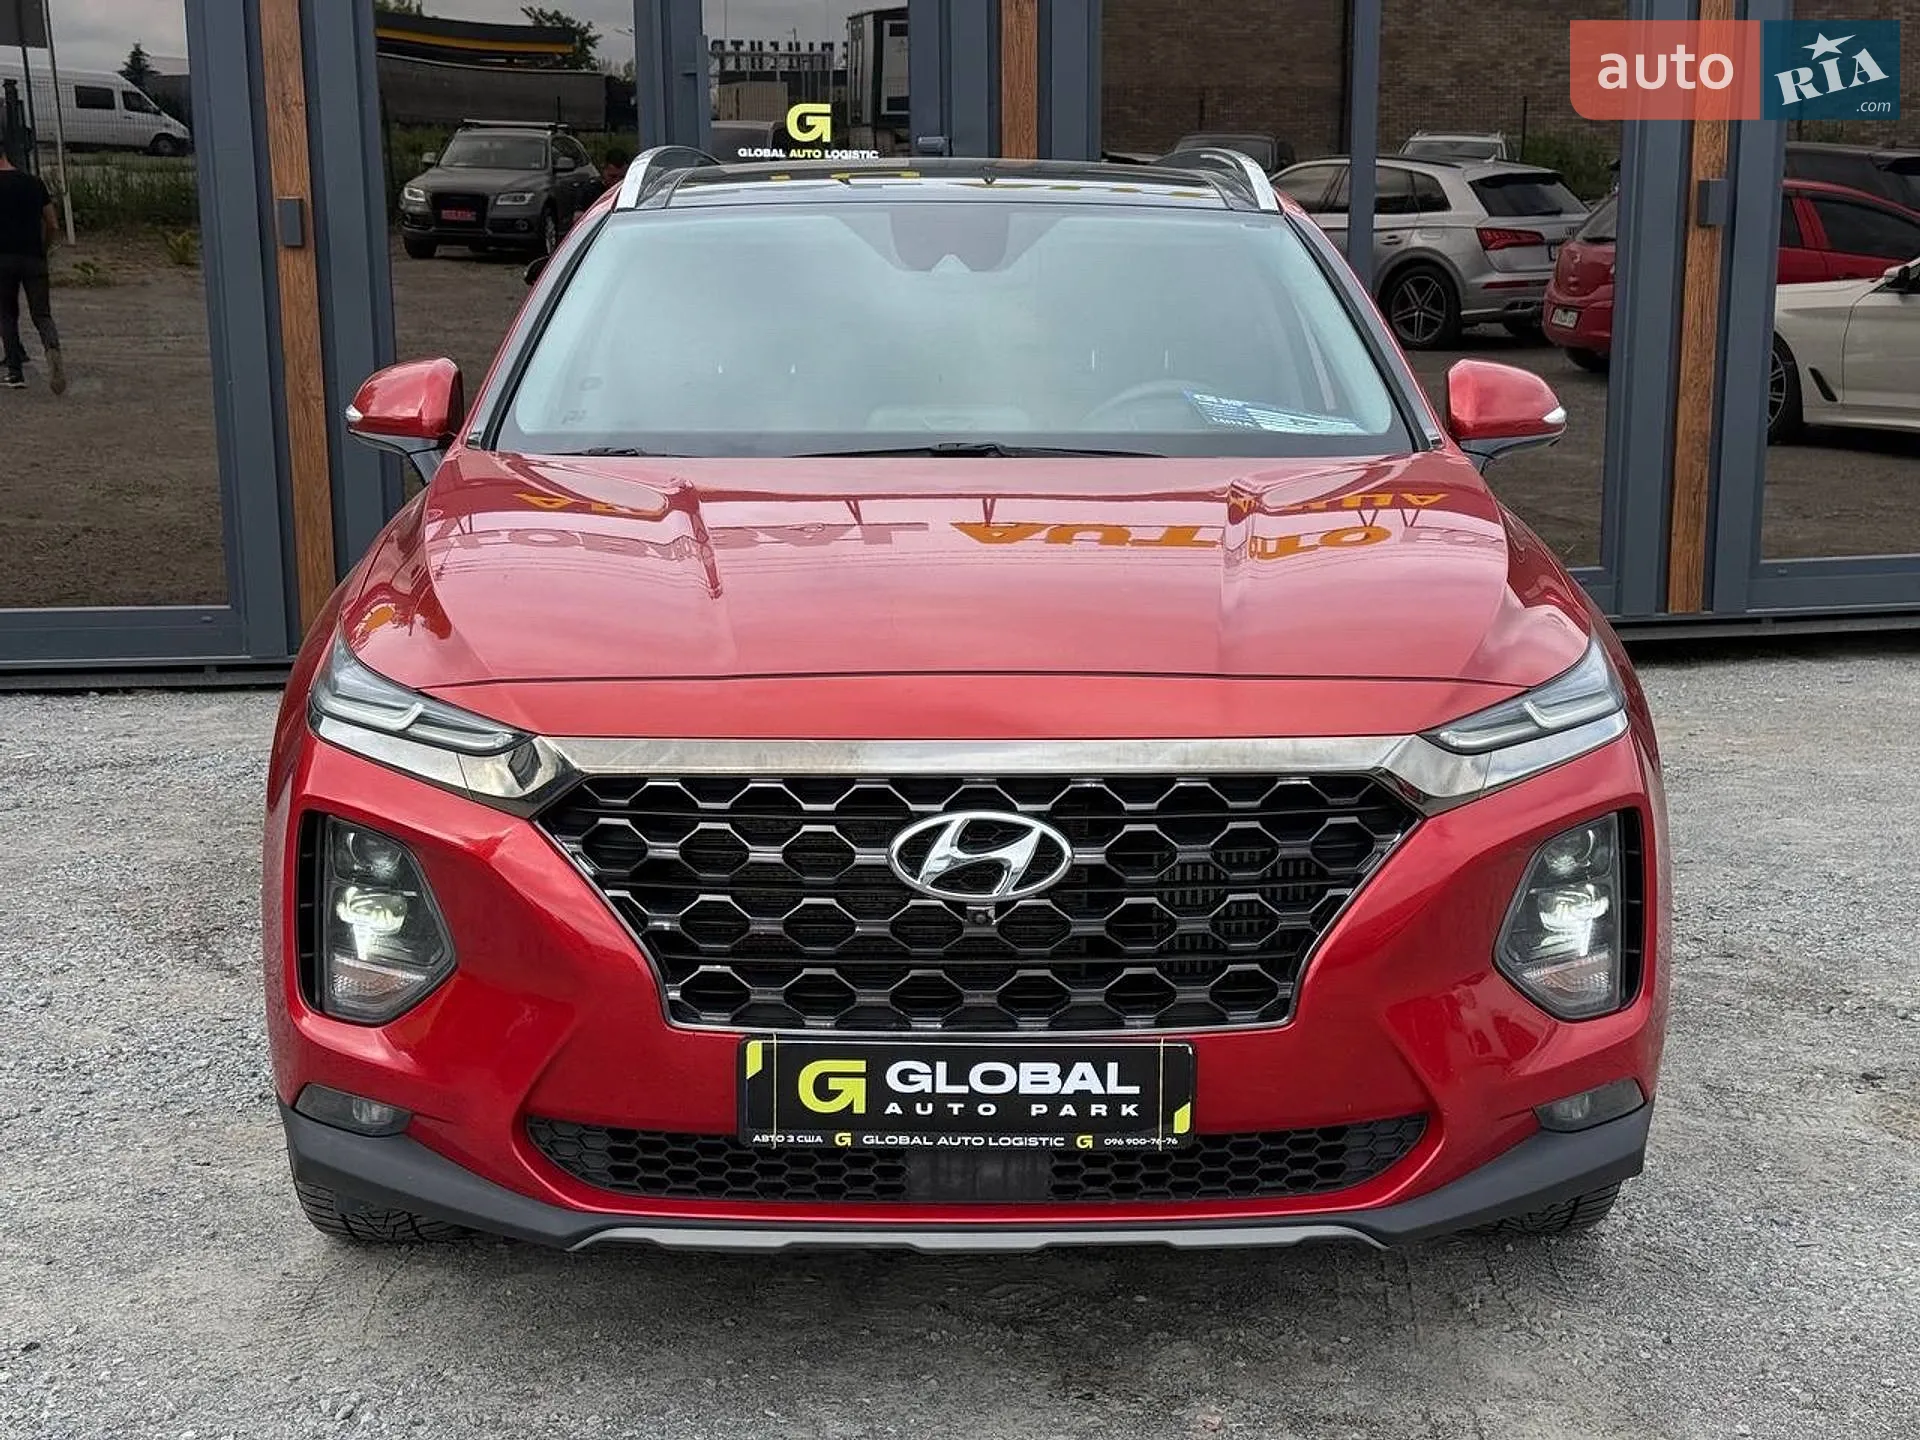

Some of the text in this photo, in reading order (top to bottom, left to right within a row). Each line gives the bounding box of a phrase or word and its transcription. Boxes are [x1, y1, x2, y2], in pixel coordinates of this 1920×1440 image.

[738, 148, 880, 160] GLOBAL AUTO LOGISTIC
[885, 1060, 1140, 1095] GLOBAL
[884, 1102, 1139, 1118] AUTO PARK
[753, 1134, 785, 1144] АВТО
[797, 1135, 824, 1144] США
[862, 1135, 1065, 1148] GLOBAL AUTO LOGISTIC
[1104, 1138, 1125, 1147] 096
